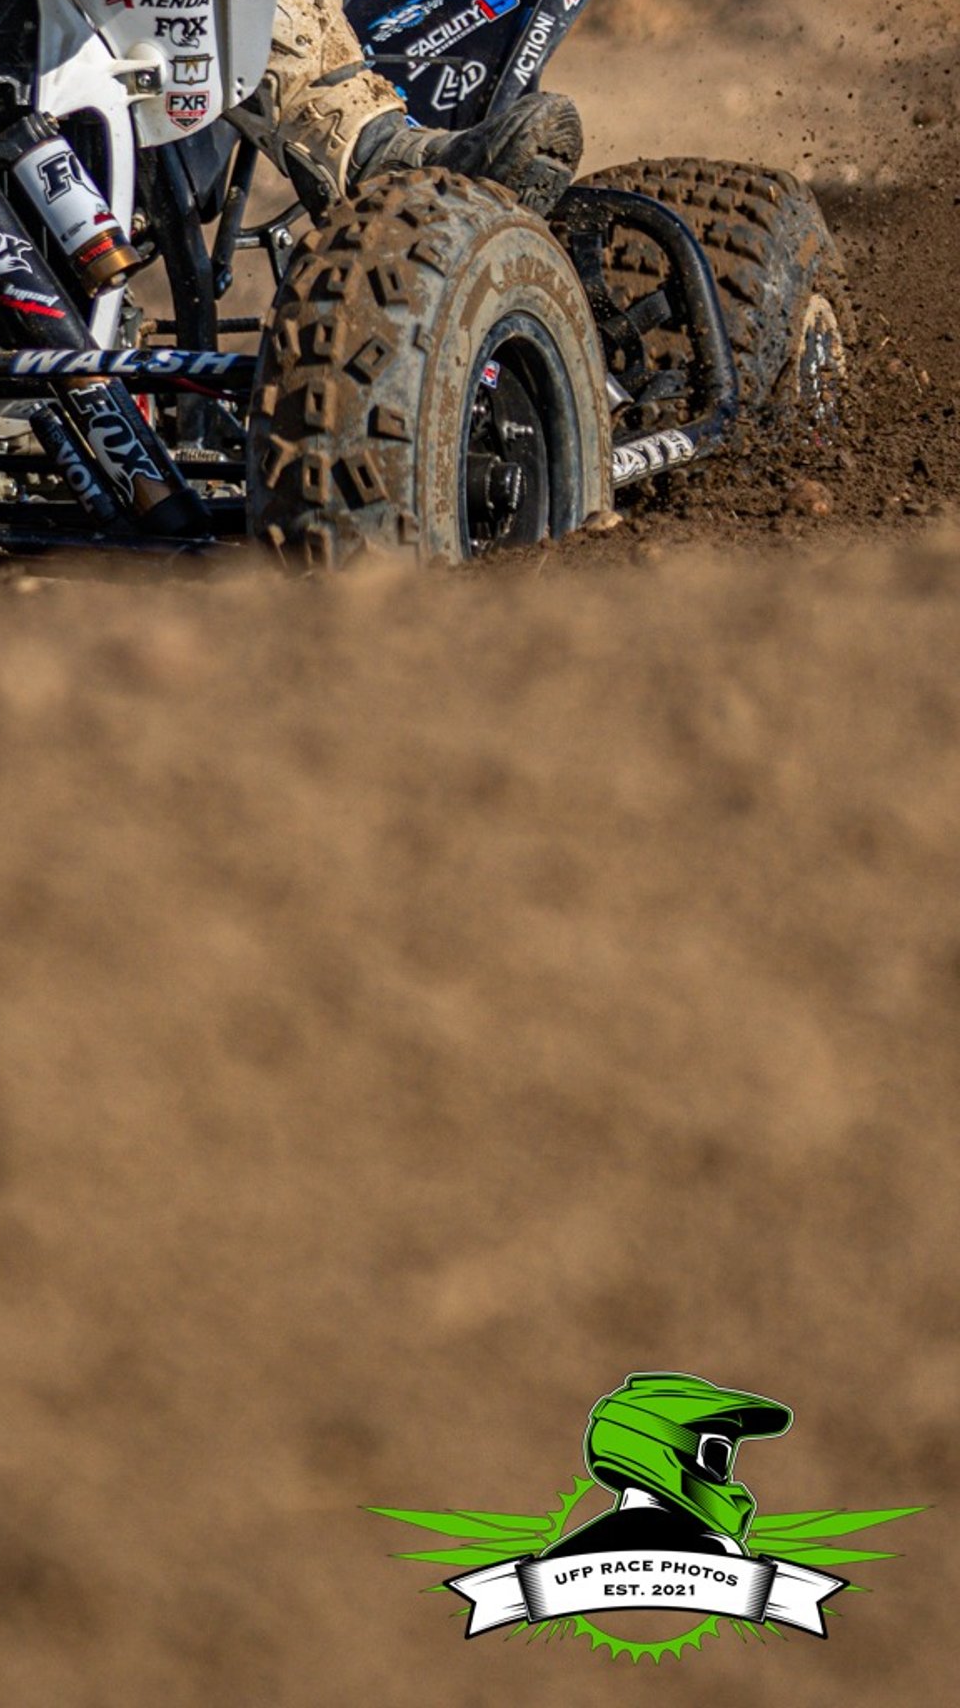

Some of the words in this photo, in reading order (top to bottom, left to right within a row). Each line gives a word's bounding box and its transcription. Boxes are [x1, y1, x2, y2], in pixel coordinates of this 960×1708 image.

[154, 15, 209, 44] FOX
[168, 94, 208, 111] FXR
[10, 348, 239, 376] WALSH
